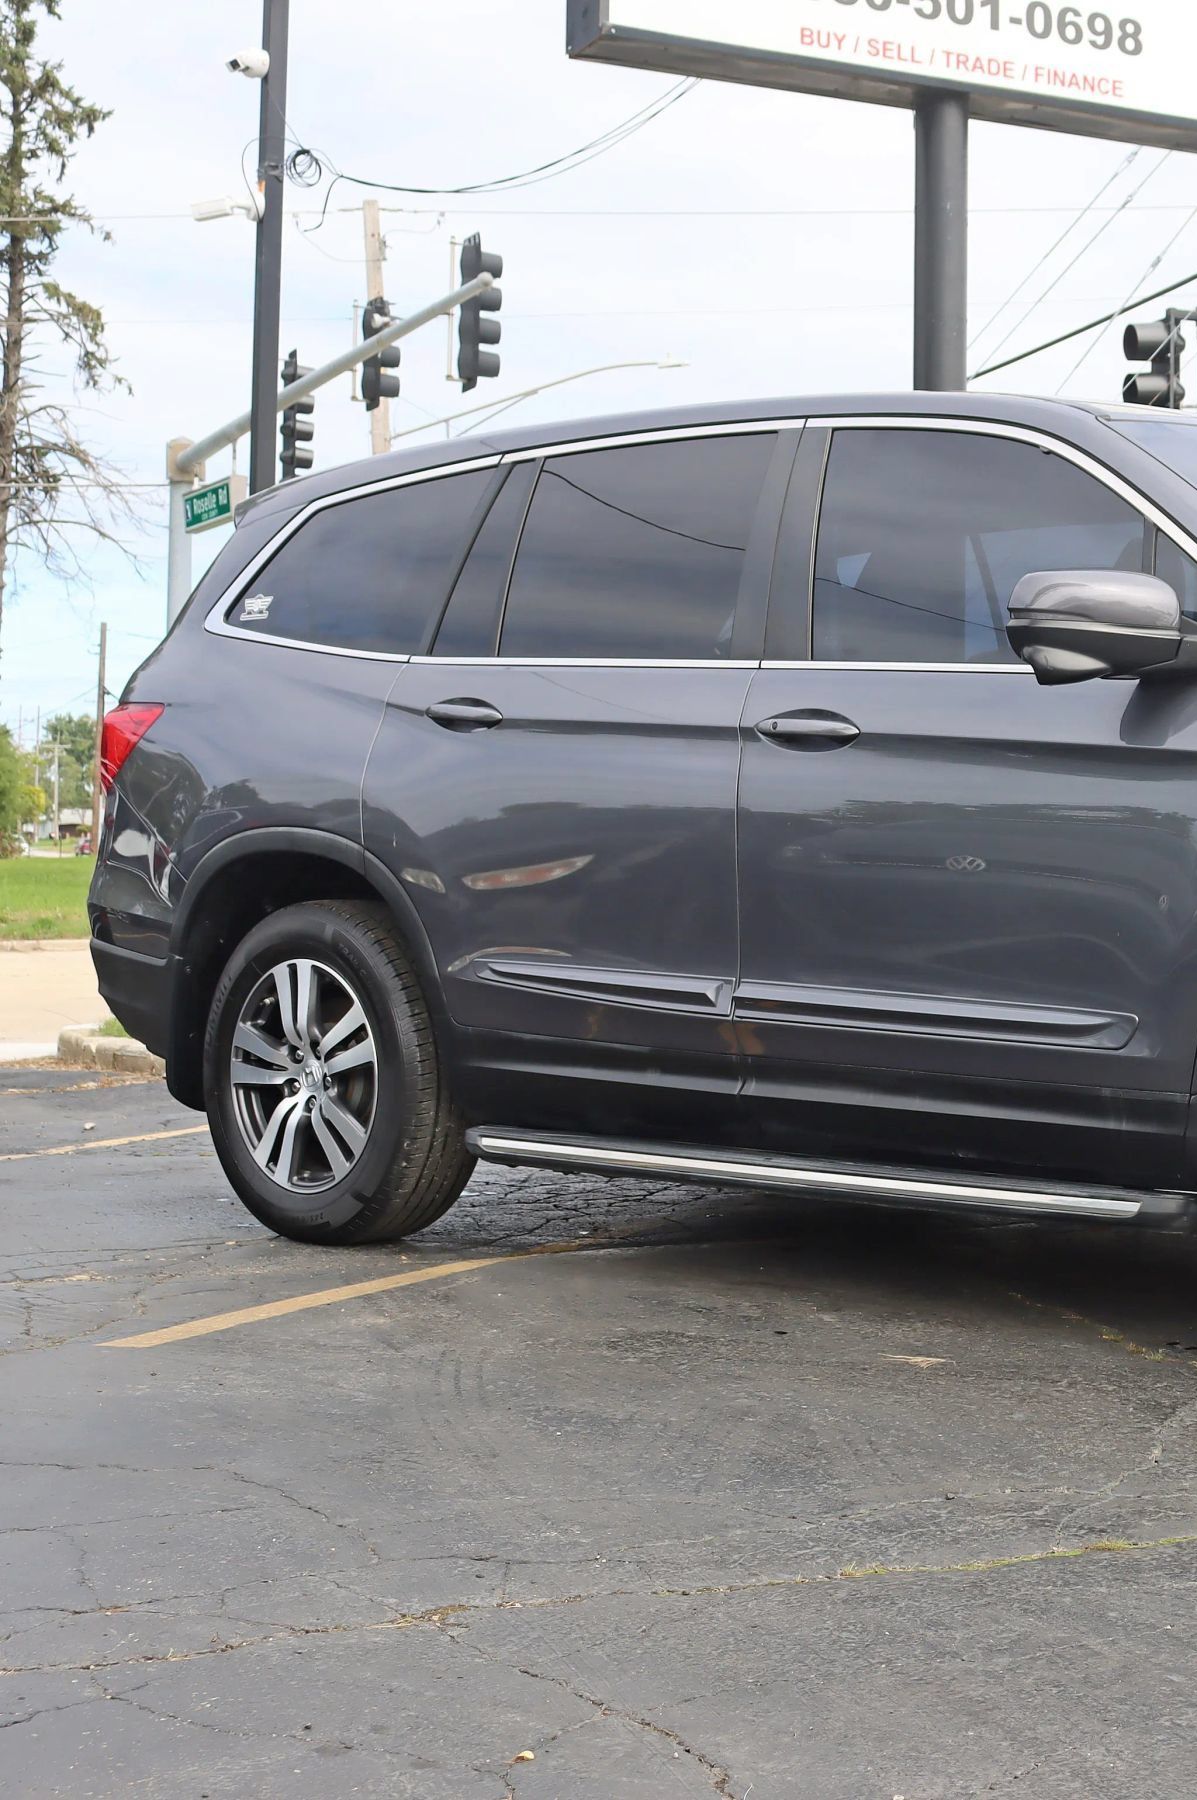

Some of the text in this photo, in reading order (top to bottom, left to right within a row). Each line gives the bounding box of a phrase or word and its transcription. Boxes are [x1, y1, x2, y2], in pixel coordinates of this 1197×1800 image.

[800, 27, 1124, 97] BUY / SELL / TRADE / FINANCE
[193, 492, 217, 515] Roselle
[218, 487, 228, 505] Rd
